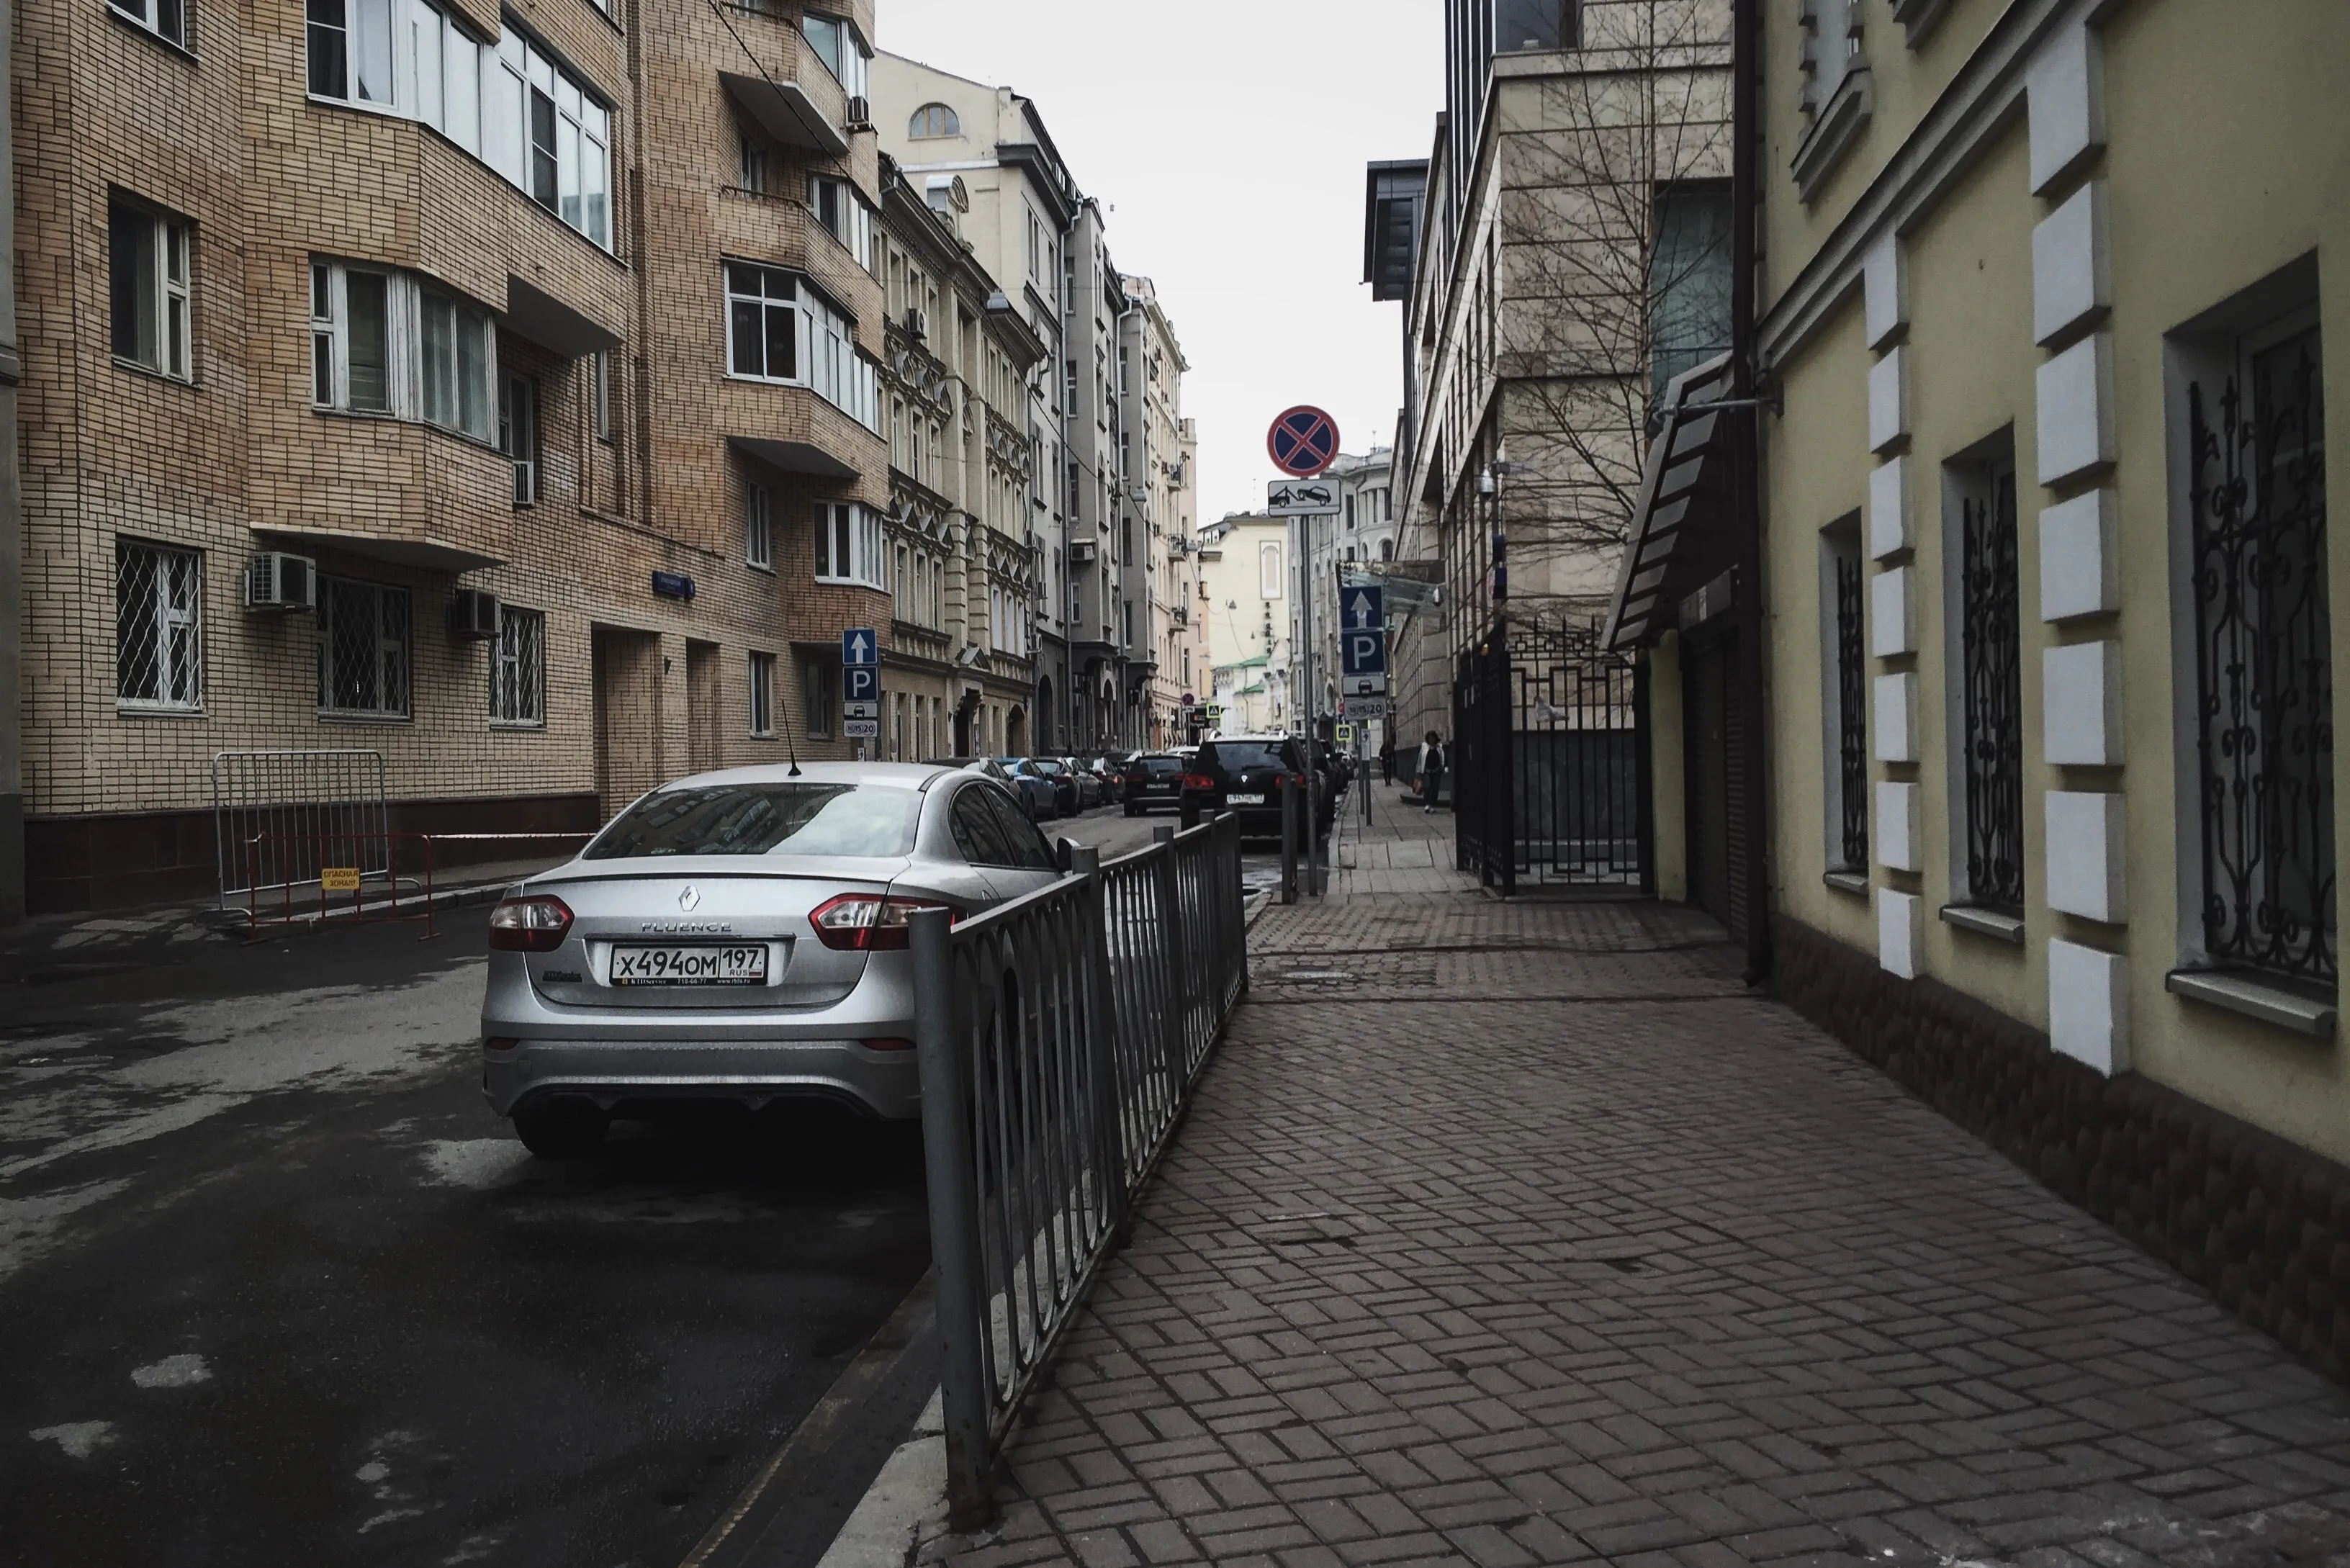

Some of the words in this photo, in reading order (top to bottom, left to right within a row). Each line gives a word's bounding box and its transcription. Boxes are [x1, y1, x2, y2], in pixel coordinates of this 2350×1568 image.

[1353, 636, 1376, 669] P
[852, 670, 870, 698] P
[1369, 703, 1382, 714] 20
[864, 724, 874, 733] 20
[323, 870, 359, 878] ОПАСНАЯ
[641, 922, 732, 932] FLUENCE
[722, 949, 760, 969] 197
